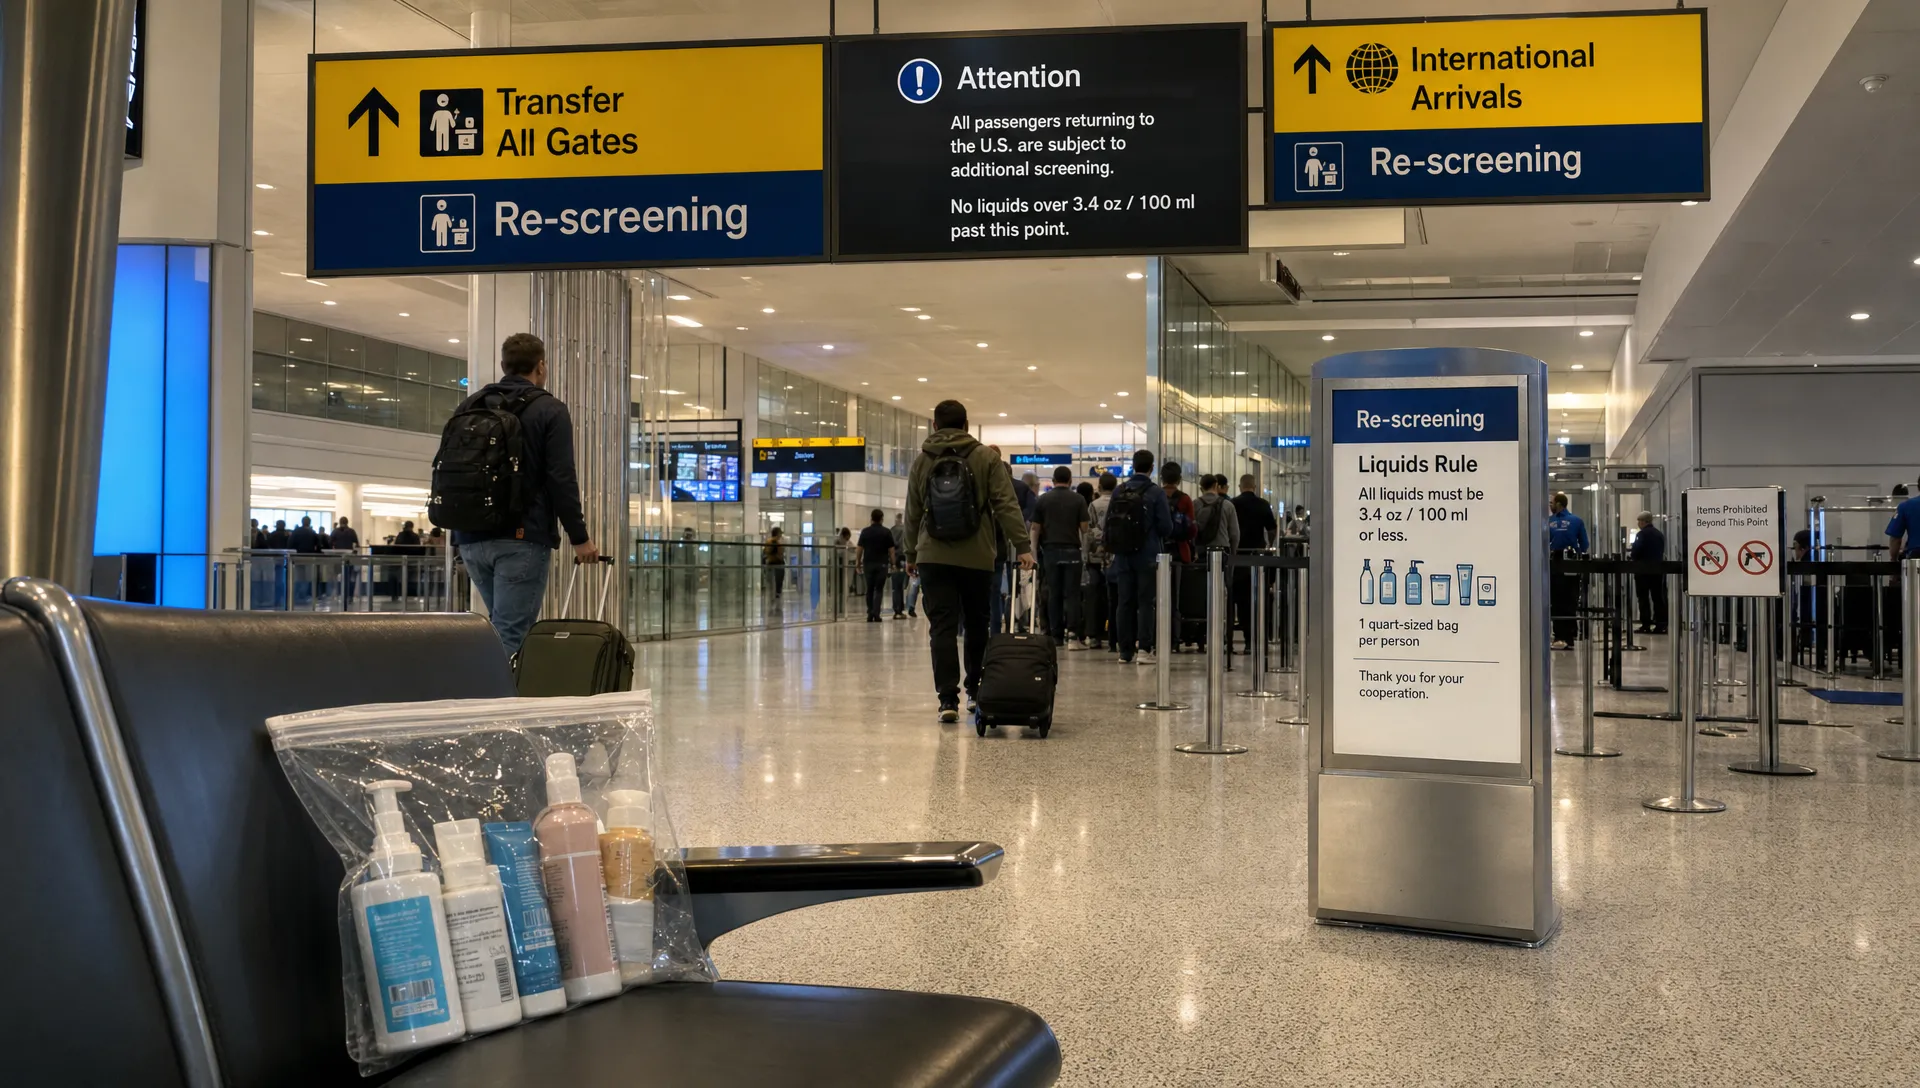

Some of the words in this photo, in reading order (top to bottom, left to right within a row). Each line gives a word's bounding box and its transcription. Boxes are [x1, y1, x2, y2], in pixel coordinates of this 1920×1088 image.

[1412, 42, 1594, 71] International
[957, 64, 1080, 89] Attention
[497, 85, 624, 115] Transfer
[1411, 83, 1522, 110] Arrivals
[951, 116, 969, 129] All
[975, 117, 1060, 133] passengers
[1066, 112, 1134, 129] returning
[1139, 113, 1154, 125] to
[497, 128, 534, 157] All
[547, 127, 638, 156] Gates
[950, 139, 975, 153] the
[981, 138, 1012, 152] U.S.
[1018, 141, 1043, 152] are
[1048, 136, 1105, 154] subject
[1110, 137, 1126, 150] to
[951, 161, 1028, 177] additional
[1035, 160, 1113, 178] screening.
[1372, 144, 1581, 179] Re-screening
[952, 199, 972, 213] No
[978, 198, 1028, 216] liquids
[1034, 201, 1068, 212] over
[1073, 196, 1099, 211] 3.4
[1104, 200, 1121, 210] oz
[1127, 196, 1134, 210] /
[1140, 195, 1171, 209] 100
[1176, 194, 1194, 209] ml
[496, 196, 747, 239] Re-screening
[952, 224, 985, 241] past
[990, 222, 1019, 236] this
[1025, 221, 1069, 240] point.
[1357, 409, 1484, 431] Re-screening
[1359, 455, 1428, 477] Liquids
[1436, 455, 1477, 472] Rule
[1359, 487, 1375, 500] All
[1380, 487, 1423, 503] liquids
[1429, 488, 1462, 500] must
[1467, 487, 1483, 500] be
[1360, 507, 1382, 521] 3.4
[1387, 512, 1402, 521] oz
[1407, 508, 1413, 521] /
[1419, 508, 1446, 521] 100
[1452, 508, 1467, 521] ml
[1697, 506, 1720, 514] Items
[1723, 505, 1767, 513] Prohibited
[1697, 519, 1725, 528] Beyond
[1728, 518, 1744, 526] This
[1747, 518, 1768, 526] Point
[1359, 532, 1374, 541] or
[1378, 528, 1407, 541] less.
[1359, 618, 1365, 630] 1
[1369, 619, 1433, 633] quart-sized
[1438, 619, 1458, 633] bag
[1359, 637, 1378, 648] per
[1381, 638, 1419, 648] person
[1359, 670, 1392, 683] Thank
[1396, 674, 1415, 686] you
[1419, 672, 1435, 683] for
[1439, 676, 1464, 686] your
[1360, 688, 1428, 700] cooperation.
